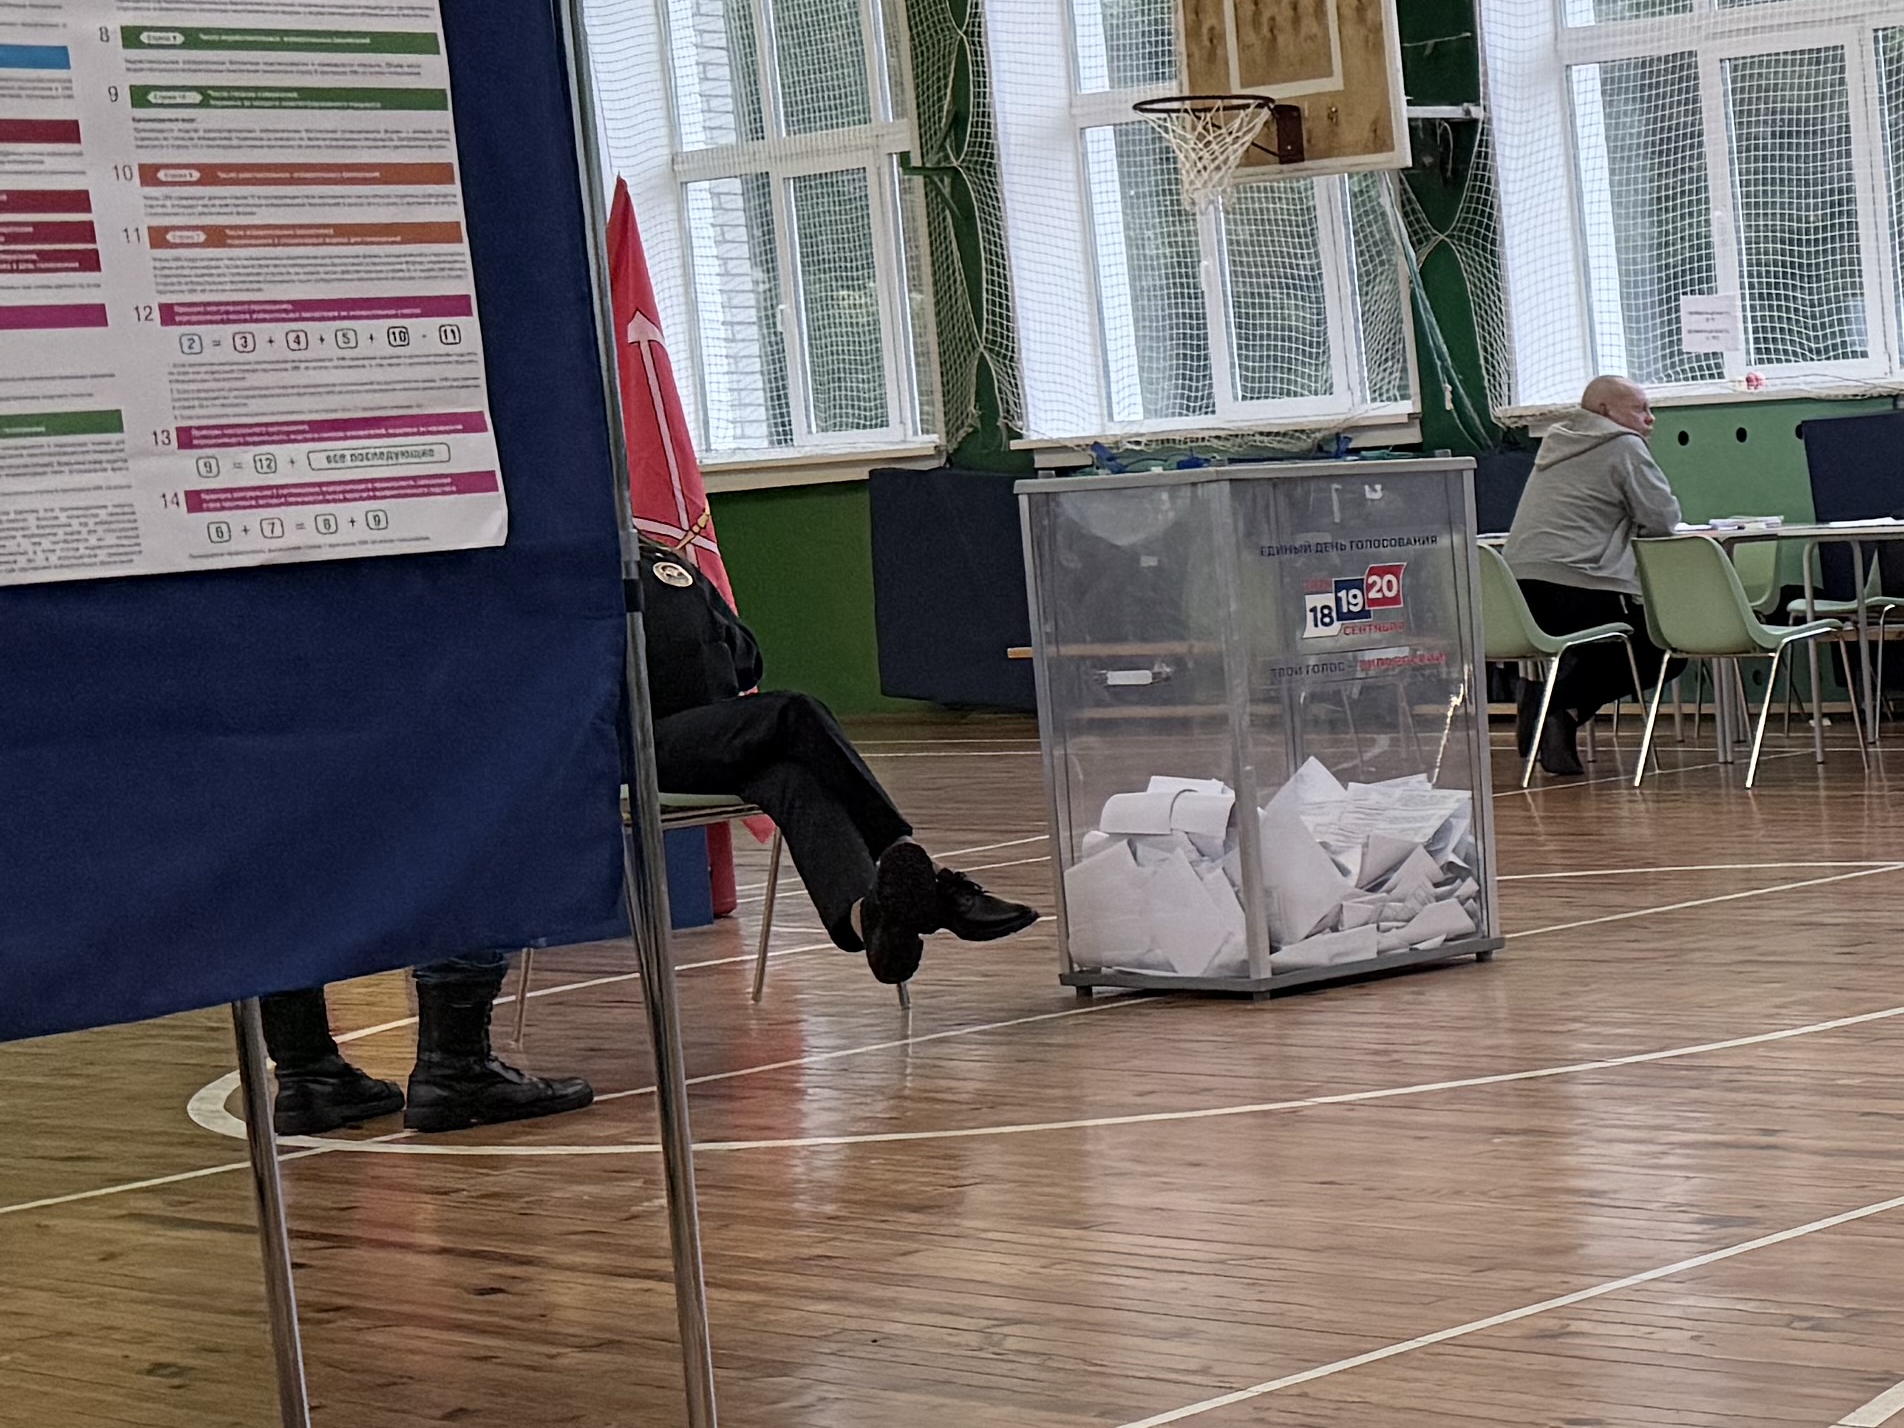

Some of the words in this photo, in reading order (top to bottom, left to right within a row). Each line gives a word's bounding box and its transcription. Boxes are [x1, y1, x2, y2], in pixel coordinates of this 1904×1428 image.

[99, 26, 110, 43] 8
[108, 85, 119, 103] 9
[113, 164, 133, 181] 10
[123, 227, 141, 244] 11
[134, 306, 153, 323] 12
[152, 429, 172, 446] 13
[161, 492, 180, 509] 14
[1260, 541, 1313, 557] ЕДИНЫЙ
[1315, 541, 1347, 555] ДЕНЬ
[1350, 535, 1438, 552] ГОЛОСОВАНИЯ
[1367, 573, 1399, 599] 20
[1337, 588, 1364, 613] 19
[1309, 604, 1335, 628] 18
